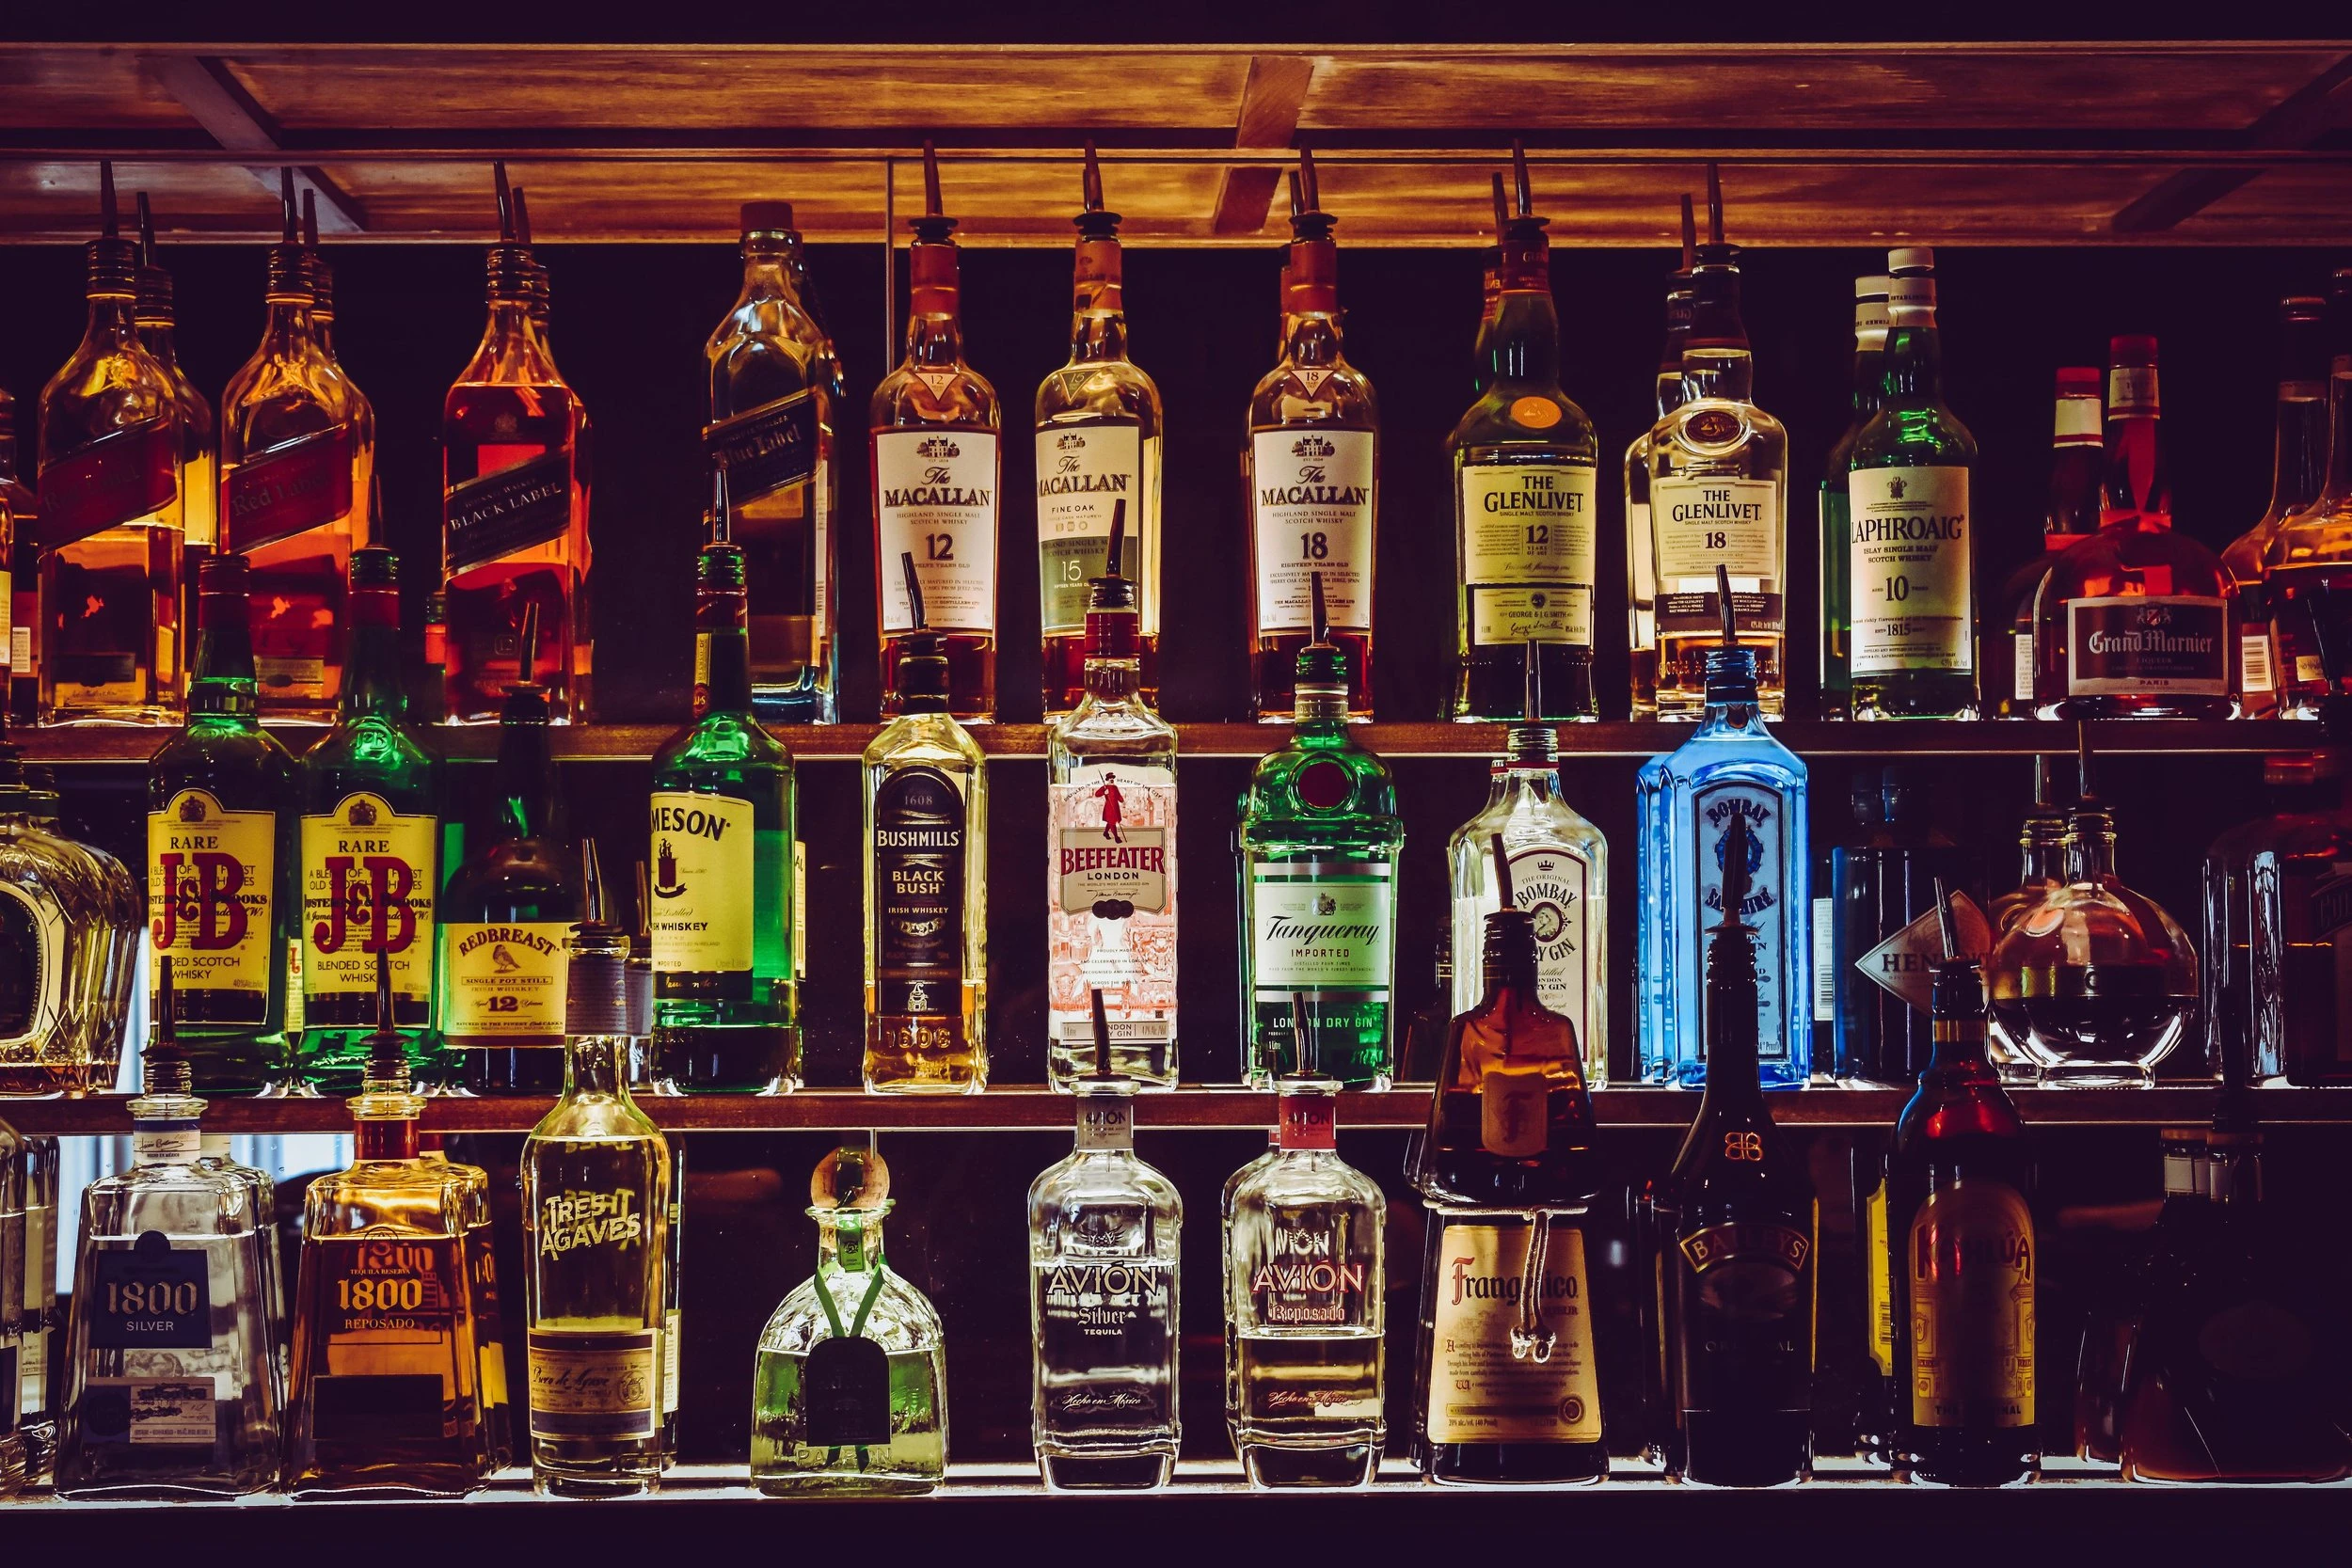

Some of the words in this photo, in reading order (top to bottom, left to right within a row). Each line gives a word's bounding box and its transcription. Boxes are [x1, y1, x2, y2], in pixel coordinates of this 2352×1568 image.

[930, 374, 944, 386] 12
[1070, 372, 1086, 384] 15
[1305, 372, 1320, 382] 18
[753, 422, 802, 456] Label
[1056, 455, 1081, 475] The
[920, 467, 951, 485] The
[1295, 466, 1326, 484] The
[1521, 475, 1553, 489] THE
[883, 487, 991, 508] MACALLAN
[1261, 486, 1369, 506] MACALLAN
[1484, 492, 1583, 513] GLENLIVET
[1702, 490, 1731, 502] THE
[450, 504, 504, 531] BLACK
[509, 482, 562, 509] LABEL
[1051, 505, 1072, 515] FINE
[1074, 504, 1095, 513] OAK
[1672, 503, 1762, 522] GLENLIVET
[1525, 524, 1549, 545] 12
[1851, 515, 1963, 544] LAPHROAIG
[925, 532, 954, 561] 12
[1300, 531, 1328, 561] 18
[1704, 531, 1727, 549] 18
[1899, 554, 1932, 562] WHISKY
[1062, 560, 1082, 581] 15
[1884, 575, 1910, 602] 10
[1887, 624, 1912, 637] 1815
[2088, 628, 2142, 656] Grand
[2142, 628, 2213, 655] Marnier
[904, 795, 933, 806] 1608
[1151, 789, 1163, 800] CITY
[1706, 798, 1772, 828] BOMBAY
[169, 836, 219, 849] RARE
[338, 840, 390, 853] RARE
[877, 830, 960, 847] BUSHMILLS
[178, 864, 193, 875] OF
[1060, 847, 1167, 877] BEEFEATER
[309, 870, 314, 879] A
[348, 868, 364, 879] OF
[892, 870, 945, 882] BLACK
[1087, 871, 1139, 880] LONDON
[1521, 875, 1536, 885] THE
[1535, 874, 1570, 885] ORIGINAL
[310, 880, 326, 891] OLD
[897, 882, 940, 895] BUSH
[1515, 881, 1578, 910] BOMBAY
[661, 922, 708, 931] WHISKEY
[1265, 915, 1380, 946] Tanqueray
[458, 927, 557, 958] REDBREAST
[1549, 937, 1577, 962] GIN
[192, 957, 241, 967] SCOTCH
[1291, 948, 1350, 958] IMPORTED
[171, 970, 212, 979] WHISKY
[317, 960, 360, 971] BLENDED
[488, 995, 518, 1012] 12
[1326, 1017, 1350, 1028] DRY
[1355, 1017, 1374, 1028] GIN
[545, 1194, 608, 1234] TRES
[540, 1212, 642, 1261] AGAVES
[1692, 1229, 1803, 1261] BAILEYS
[1047, 1259, 1158, 1296] AVIÓN
[1251, 1259, 1366, 1294] AVIÓN
[106, 1280, 199, 1316] 1800
[337, 1277, 423, 1311] 1800
[1076, 1306, 1128, 1327] Silver
[1268, 1303, 1346, 1324] Reposado
[125, 1321, 175, 1332] SILVER
[344, 1318, 416, 1329] REPOSADO
[532, 1365, 554, 1384] Puro
[555, 1369, 570, 1386] de
[1062, 1392, 1092, 1411] Hecho
[1104, 1391, 1142, 1407] México
[1268, 1391, 1305, 1411] Hecho
